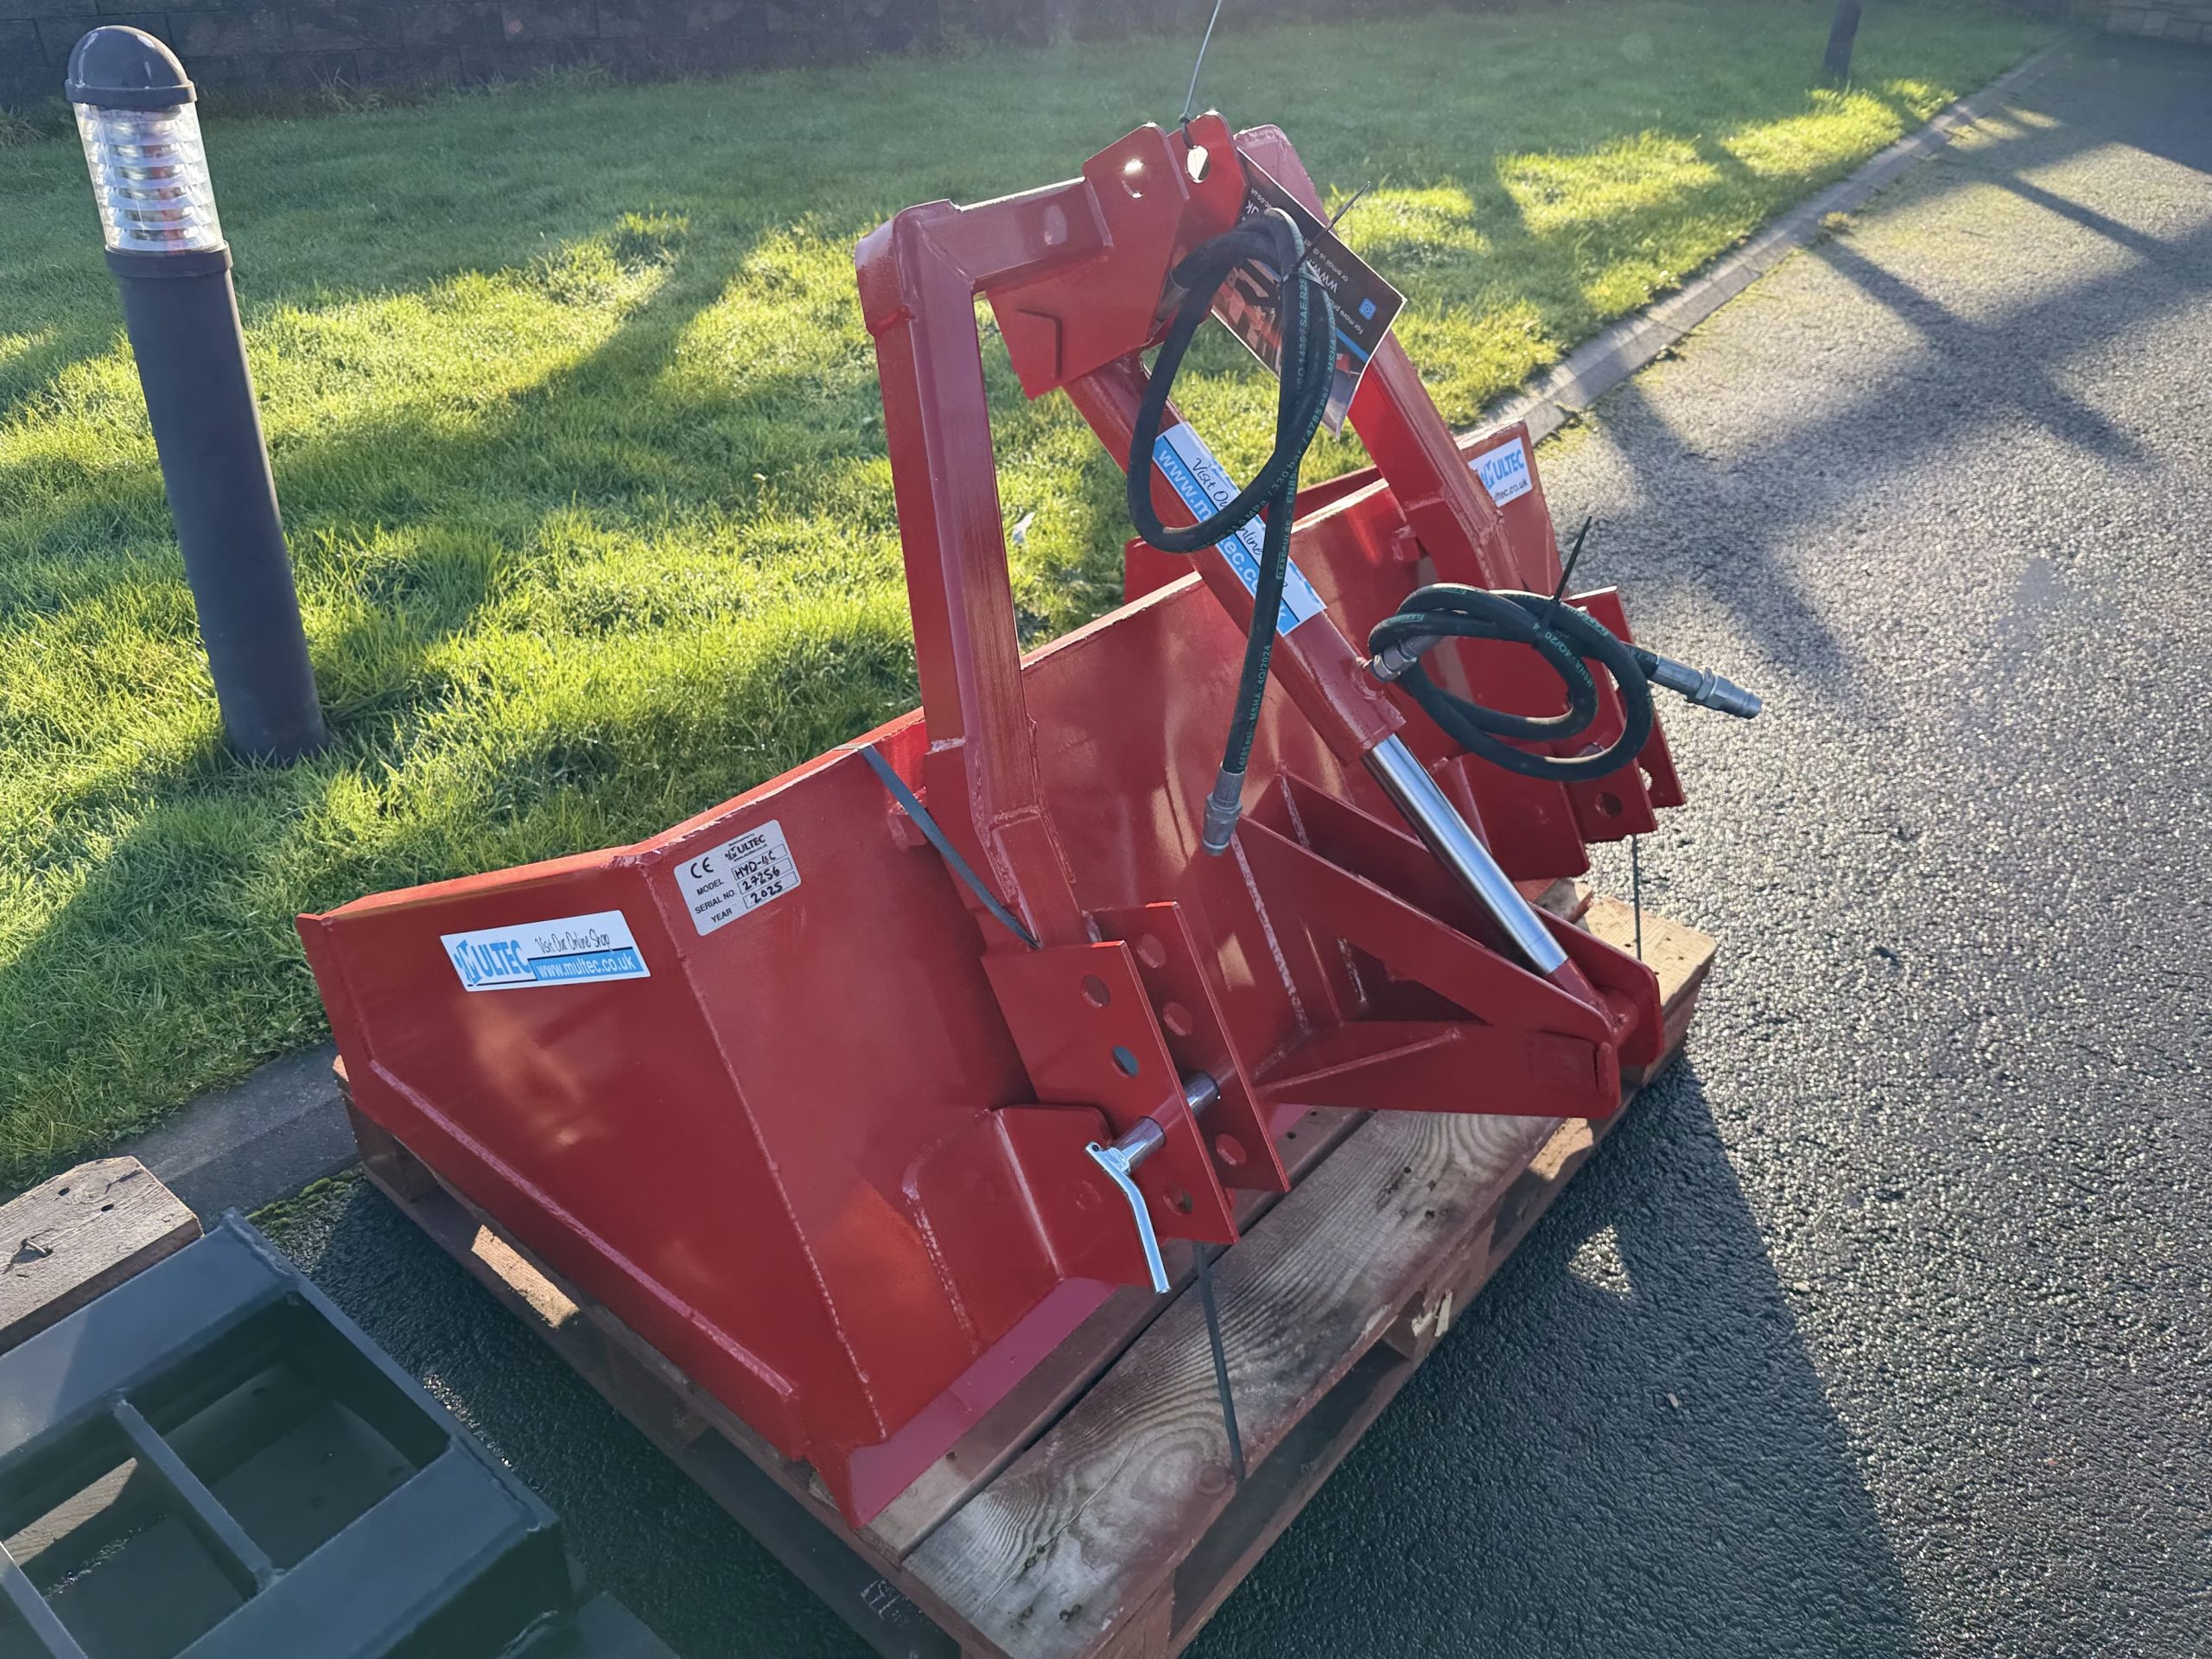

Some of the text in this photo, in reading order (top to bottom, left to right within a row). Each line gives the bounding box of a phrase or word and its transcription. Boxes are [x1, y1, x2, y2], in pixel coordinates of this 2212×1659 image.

[1299, 302, 1308, 327] SAE
[1306, 407, 1323, 438] 4785
[1194, 457, 1263, 556] Visit Ou nline
[1533, 622, 1572, 657] 4Q/204
[1249, 694, 1262, 721] MSHA
[724, 835, 766, 861] MULTEC
[696, 878, 724, 896] MODEL
[742, 866, 781, 891] 27256
[695, 896, 722, 914] SERIAL
[750, 881, 783, 904] 2025
[710, 907, 733, 924] YEAR
[534, 928, 614, 955] Visit Our Online Shop
[454, 939, 533, 985] MULTEC
[536, 954, 637, 979] www.multec.co.uk
